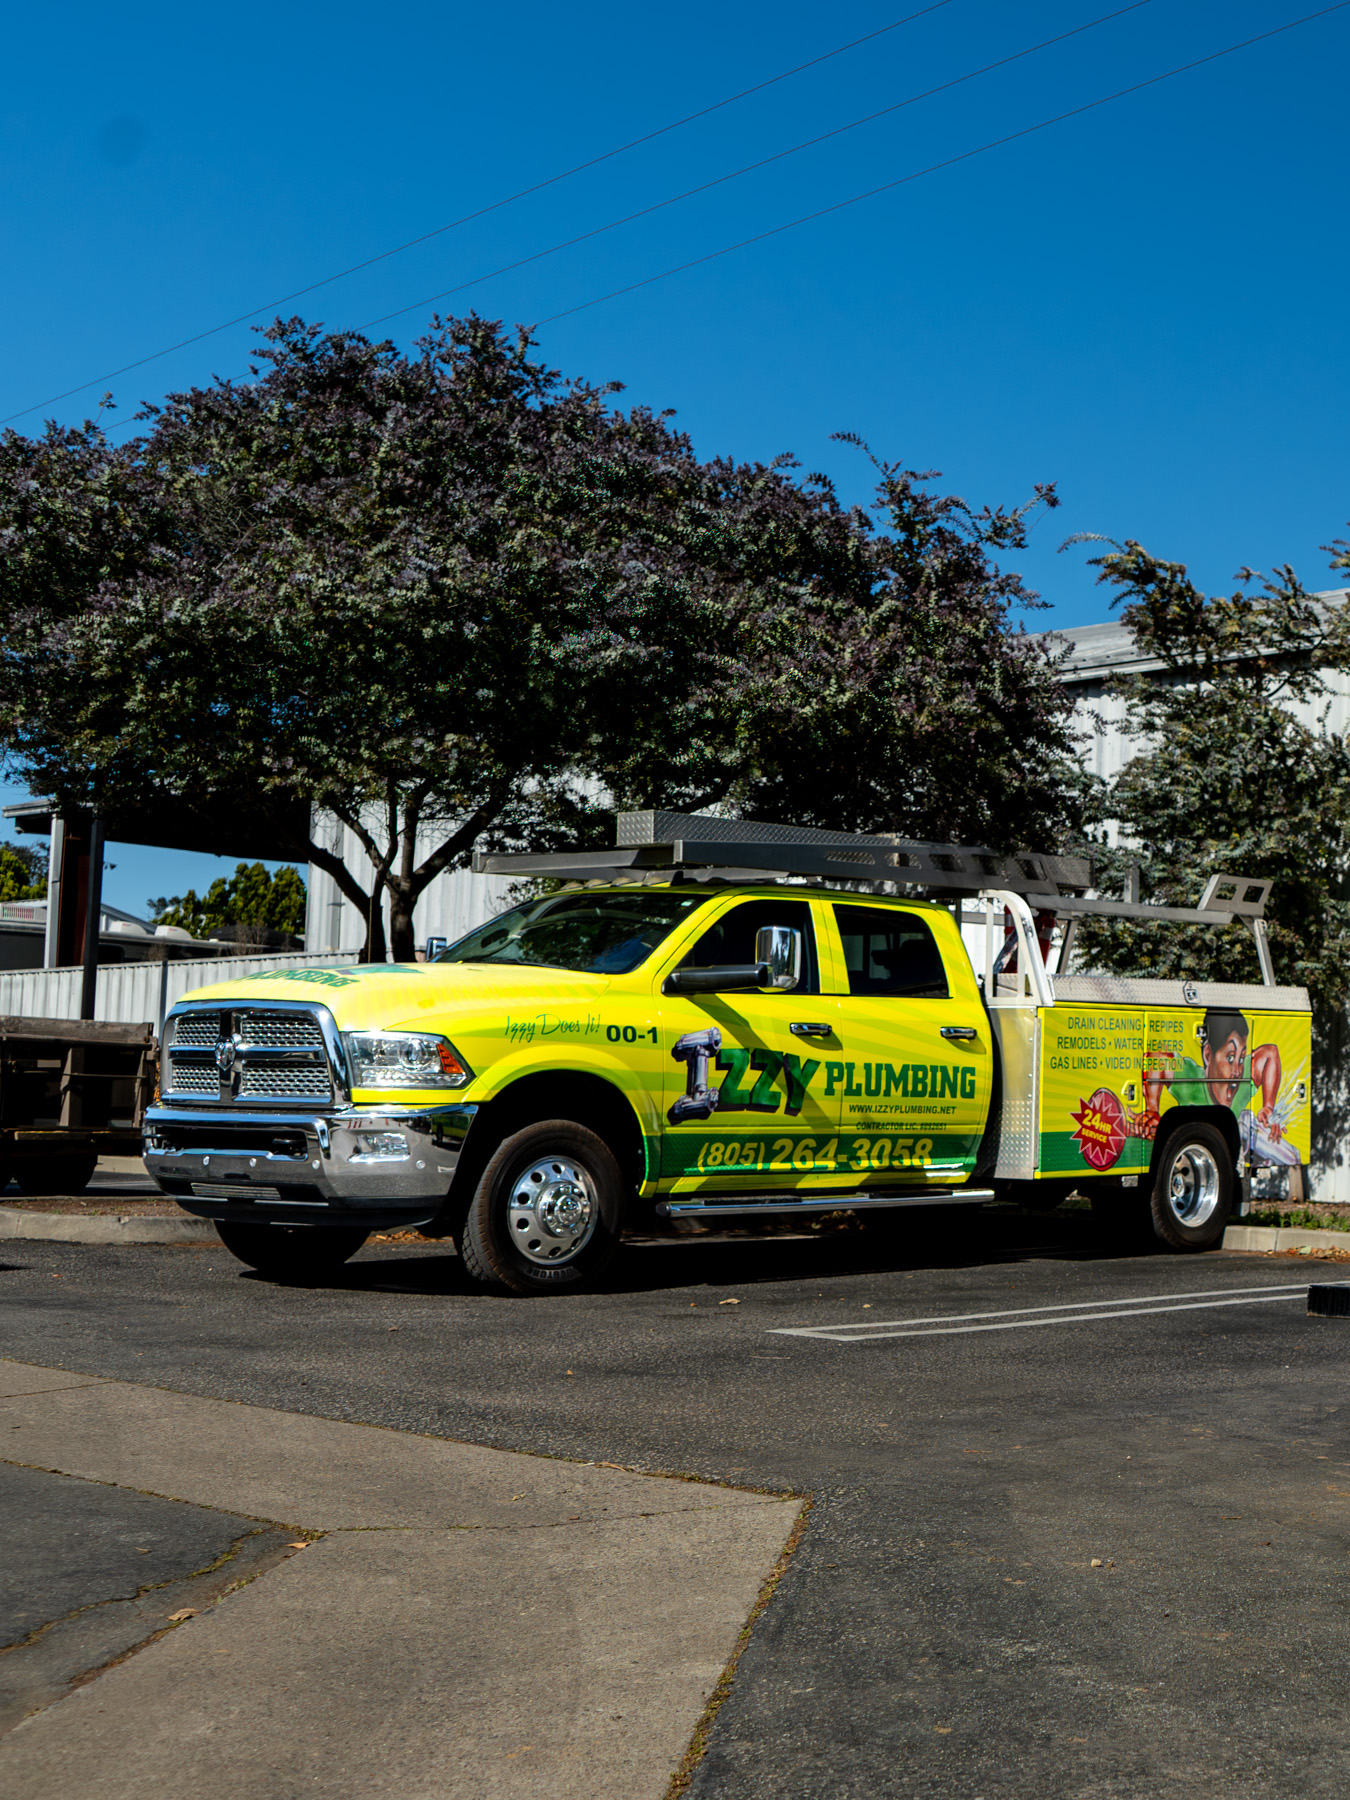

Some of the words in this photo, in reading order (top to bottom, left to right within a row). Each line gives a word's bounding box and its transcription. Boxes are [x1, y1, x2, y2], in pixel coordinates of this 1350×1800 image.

[505, 1015, 536, 1043] Izzy
[536, 1013, 580, 1035] Does
[585, 1013, 601, 1036] It!
[1068, 1016, 1095, 1030] DRAIN
[1098, 1018, 1141, 1031] CLEANING
[1149, 1020, 1184, 1033] REPIPES
[606, 1024, 658, 1044] 00-1
[1057, 1037, 1107, 1050] REMODELS
[1114, 1038, 1144, 1050] WATER
[1147, 1038, 1184, 1052] HEATERS
[1050, 1056, 1069, 1069] GAS
[1072, 1056, 1098, 1070] LINES
[1105, 1057, 1132, 1070] VIDEO
[1133, 1057, 1183, 1072] INSPECTION
[667, 1026, 821, 1126] IZZY
[824, 1061, 976, 1099] PLUMBING
[849, 1104, 957, 1115] WWW.IZZYPLUMBING.NET
[856, 1122, 903, 1131] CONTRACTOR
[1081, 1128, 1108, 1143] SERVICE
[698, 1141, 764, 1172] (805)
[769, 1137, 934, 1172] 264-3058
